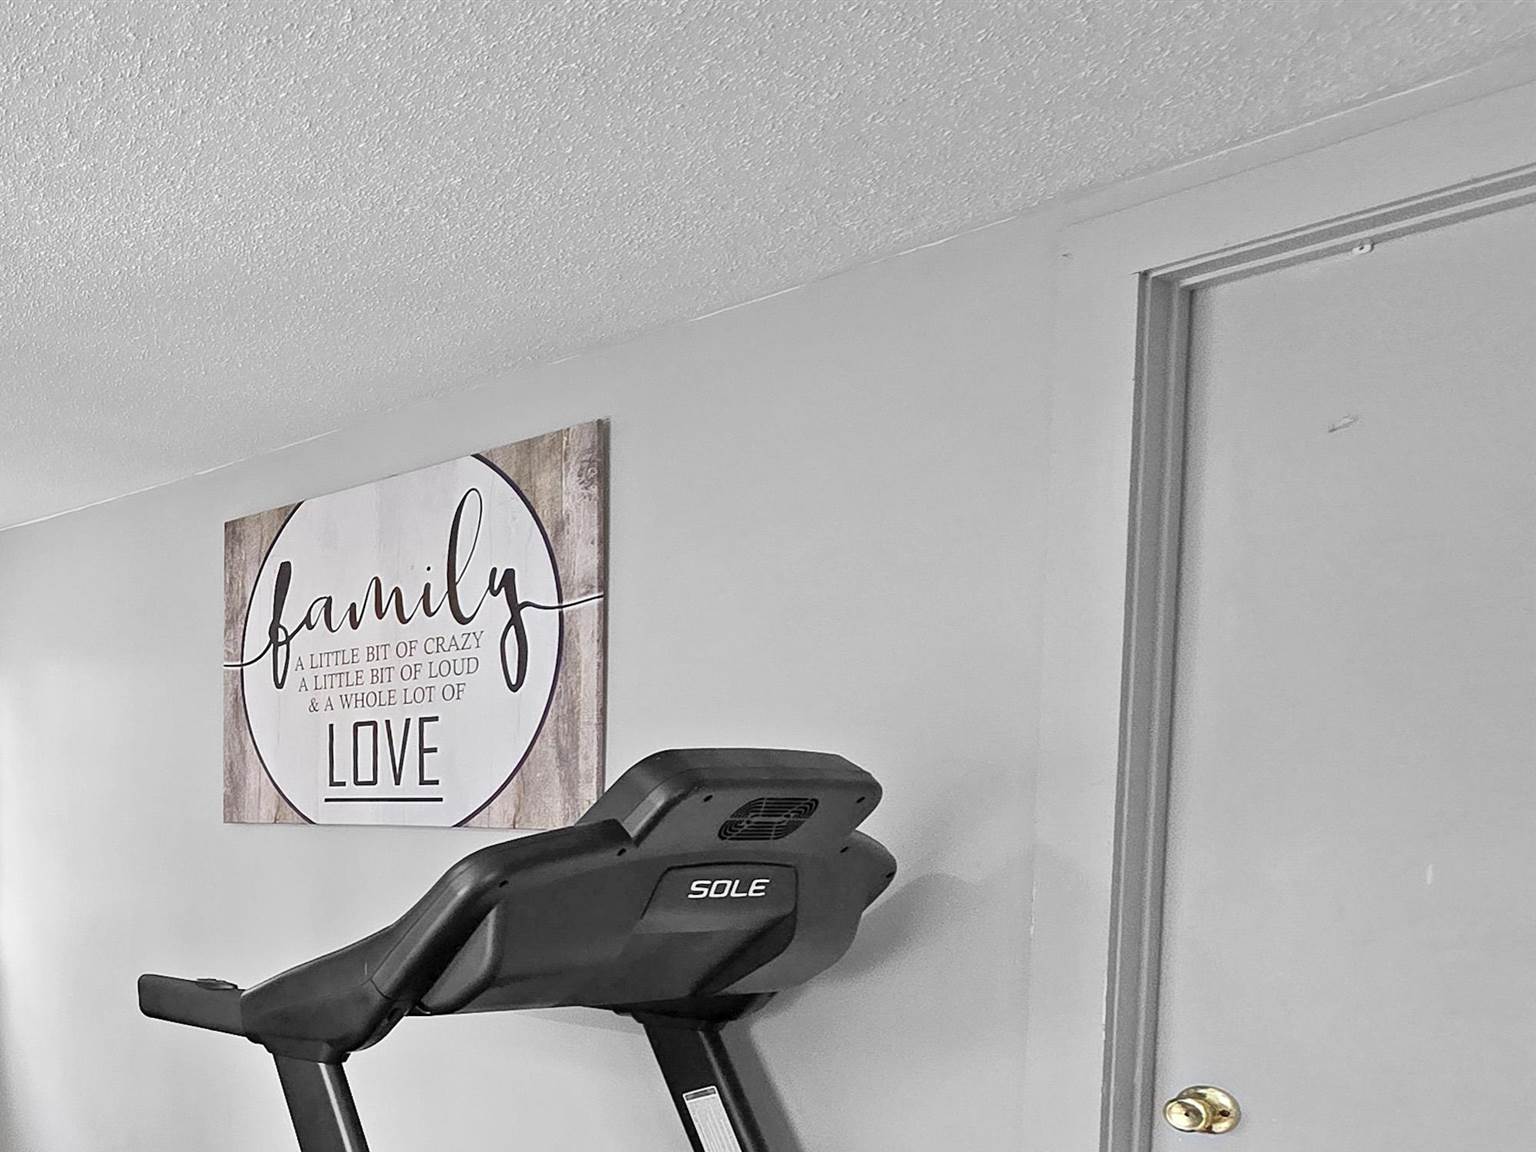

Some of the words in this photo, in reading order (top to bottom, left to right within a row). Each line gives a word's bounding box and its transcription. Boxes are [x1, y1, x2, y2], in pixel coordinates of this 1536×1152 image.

[262, 487, 531, 693] family
[294, 656, 305, 671] A
[310, 648, 361, 669] LITTLE
[366, 643, 391, 662] BIT
[395, 640, 418, 658] OF
[423, 630, 484, 655] CRAZY
[298, 677, 308, 692] A
[314, 669, 364, 690] LITTLE
[370, 666, 395, 685] BIT
[400, 663, 423, 681] OF
[428, 656, 479, 678] LOUD
[308, 697, 319, 713] &
[324, 696, 334, 712] A
[339, 689, 397, 710] WHOLE
[403, 685, 436, 704] LOT
[441, 682, 466, 701] OF
[327, 715, 440, 787] LOVE
[687, 878, 770, 899] SOLE
